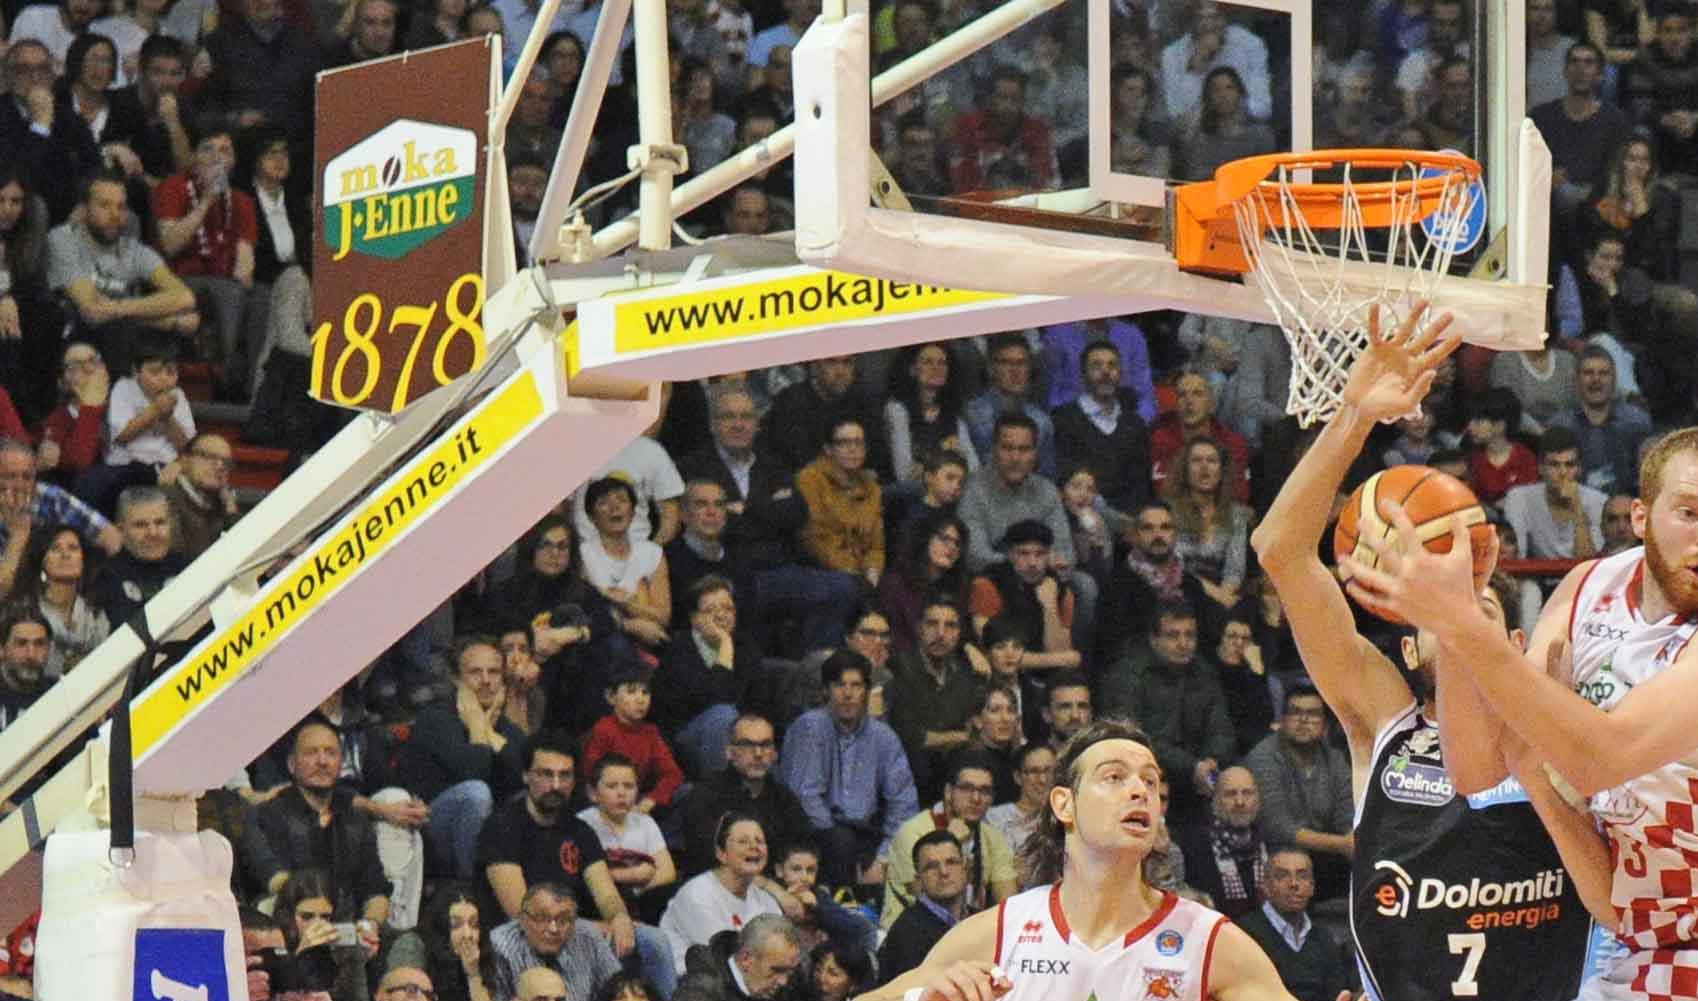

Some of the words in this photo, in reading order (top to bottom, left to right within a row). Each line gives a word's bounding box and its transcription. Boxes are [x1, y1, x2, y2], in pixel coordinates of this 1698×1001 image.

[338, 140, 459, 196] moka
[309, 273, 486, 414] 1878
[176, 426, 482, 702] www.mokajenne.it
[1416, 868, 1564, 910] Dolomiti
[1466, 902, 1559, 930] energia
[1020, 959, 1071, 975] FLEXX
[1447, 933, 1487, 997] 7
